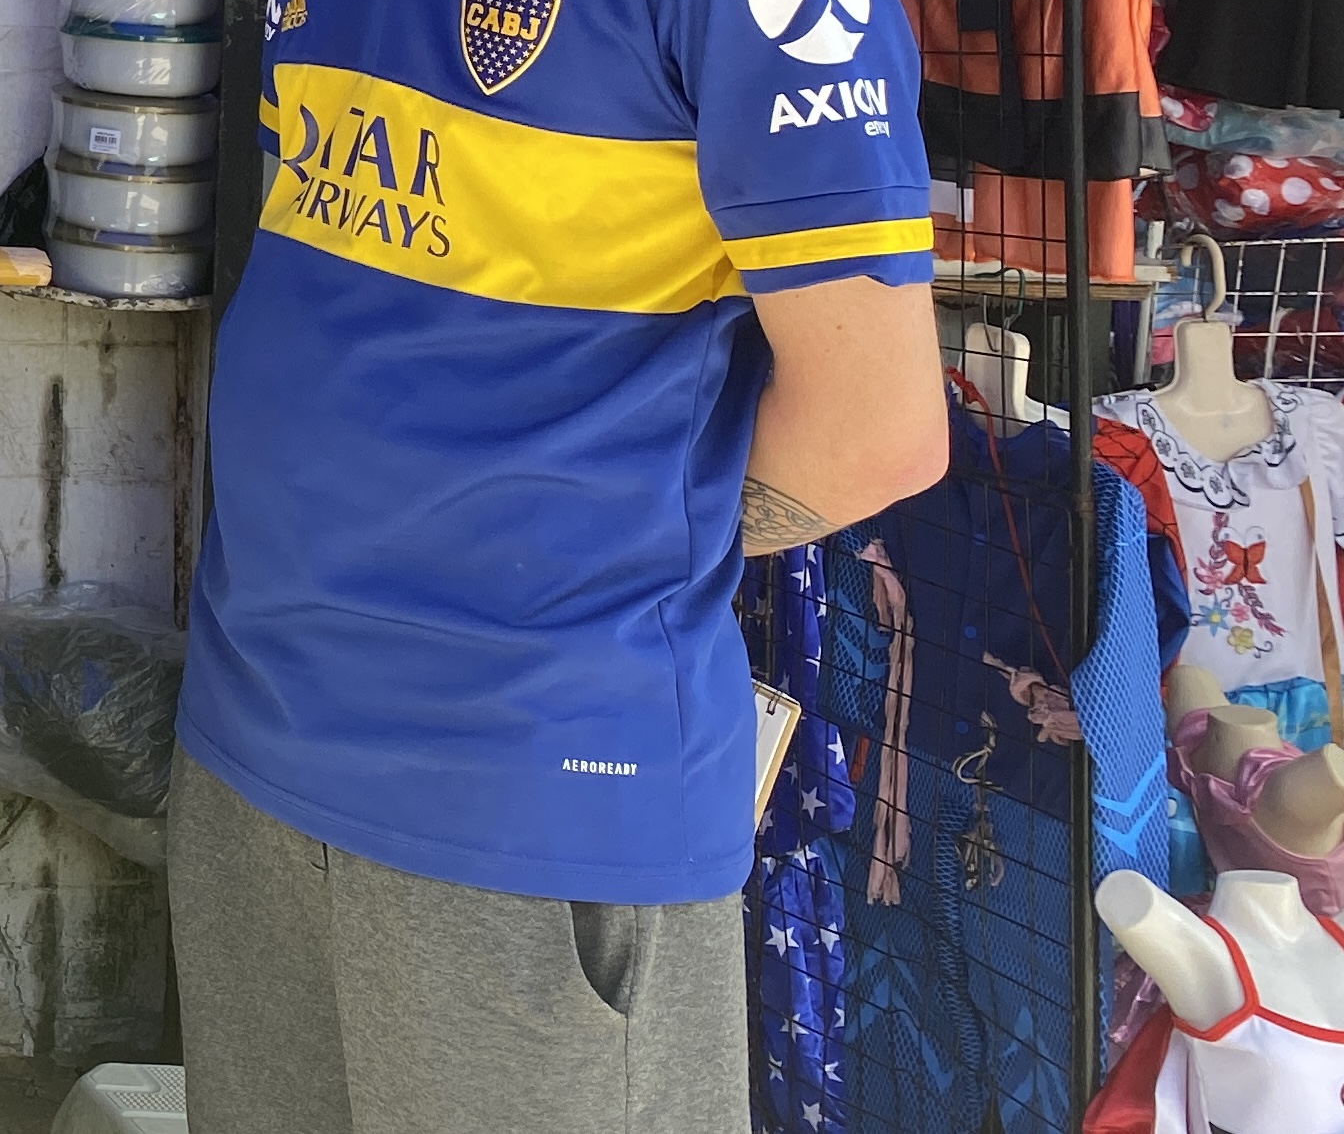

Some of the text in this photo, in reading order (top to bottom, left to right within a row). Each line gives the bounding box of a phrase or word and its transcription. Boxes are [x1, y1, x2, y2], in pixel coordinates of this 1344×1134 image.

[465, 1, 542, 42] CABJ
[769, 78, 889, 134] AXION
[562, 757, 638, 777] AEROREADY
